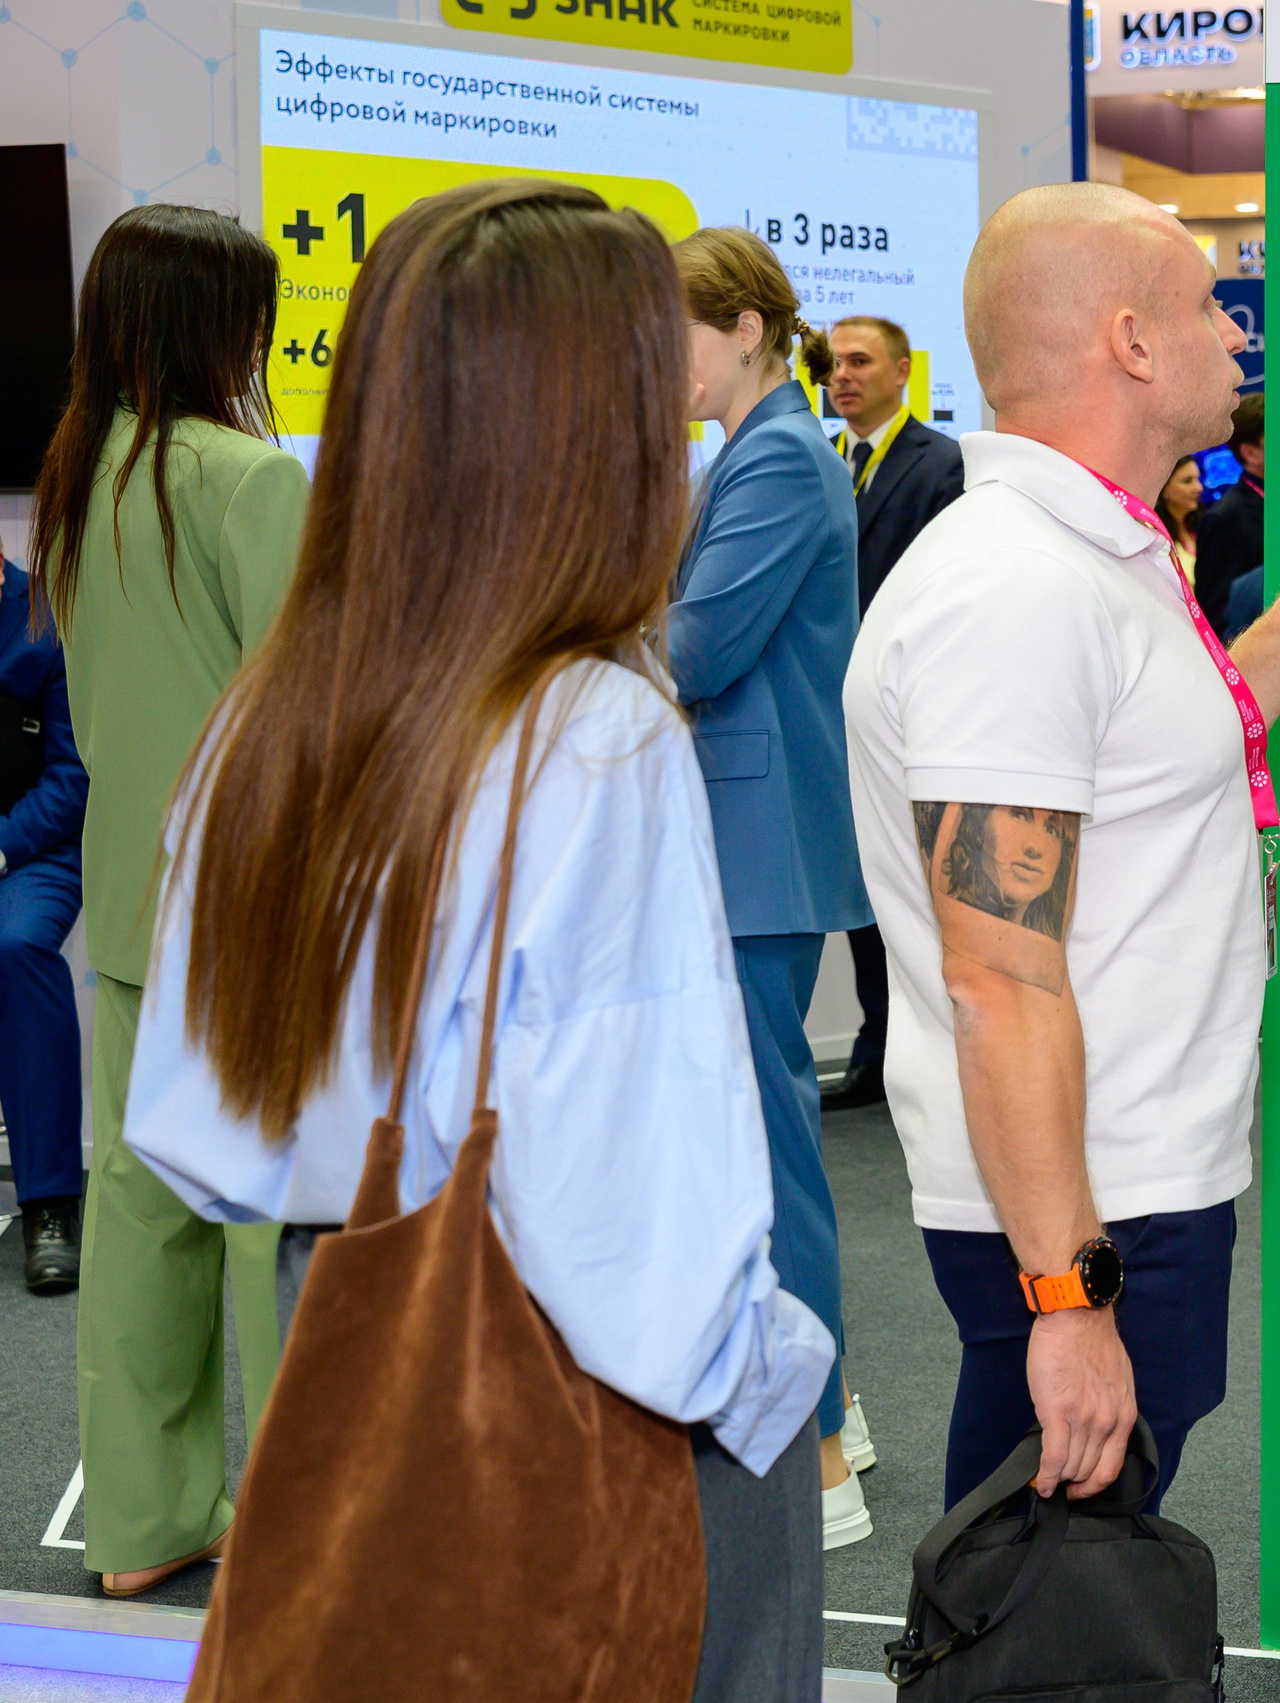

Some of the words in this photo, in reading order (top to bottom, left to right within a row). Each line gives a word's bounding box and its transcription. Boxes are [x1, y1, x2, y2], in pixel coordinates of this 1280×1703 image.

[766, 4, 842, 28] ЦИФРОВОЙ
[1121, 9, 1264, 42] КИРО
[692, 18, 791, 43] МАРКИРОВКИ
[1120, 46, 1237, 69] ОБЛАСТЬ
[274, 49, 395, 85] Эффекты
[402, 67, 601, 108] государственной
[608, 91, 700, 118] системы
[276, 93, 406, 124] цифровой
[414, 110, 558, 139] маркировки
[767, 218, 782, 243] в
[794, 213, 809, 245] 3
[821, 222, 889, 255] раза
[812, 266, 916, 286] нелегальный
[280, 278, 350, 302] Эконо
[815, 285, 826, 304] 5
[829, 290, 855, 305] лет
